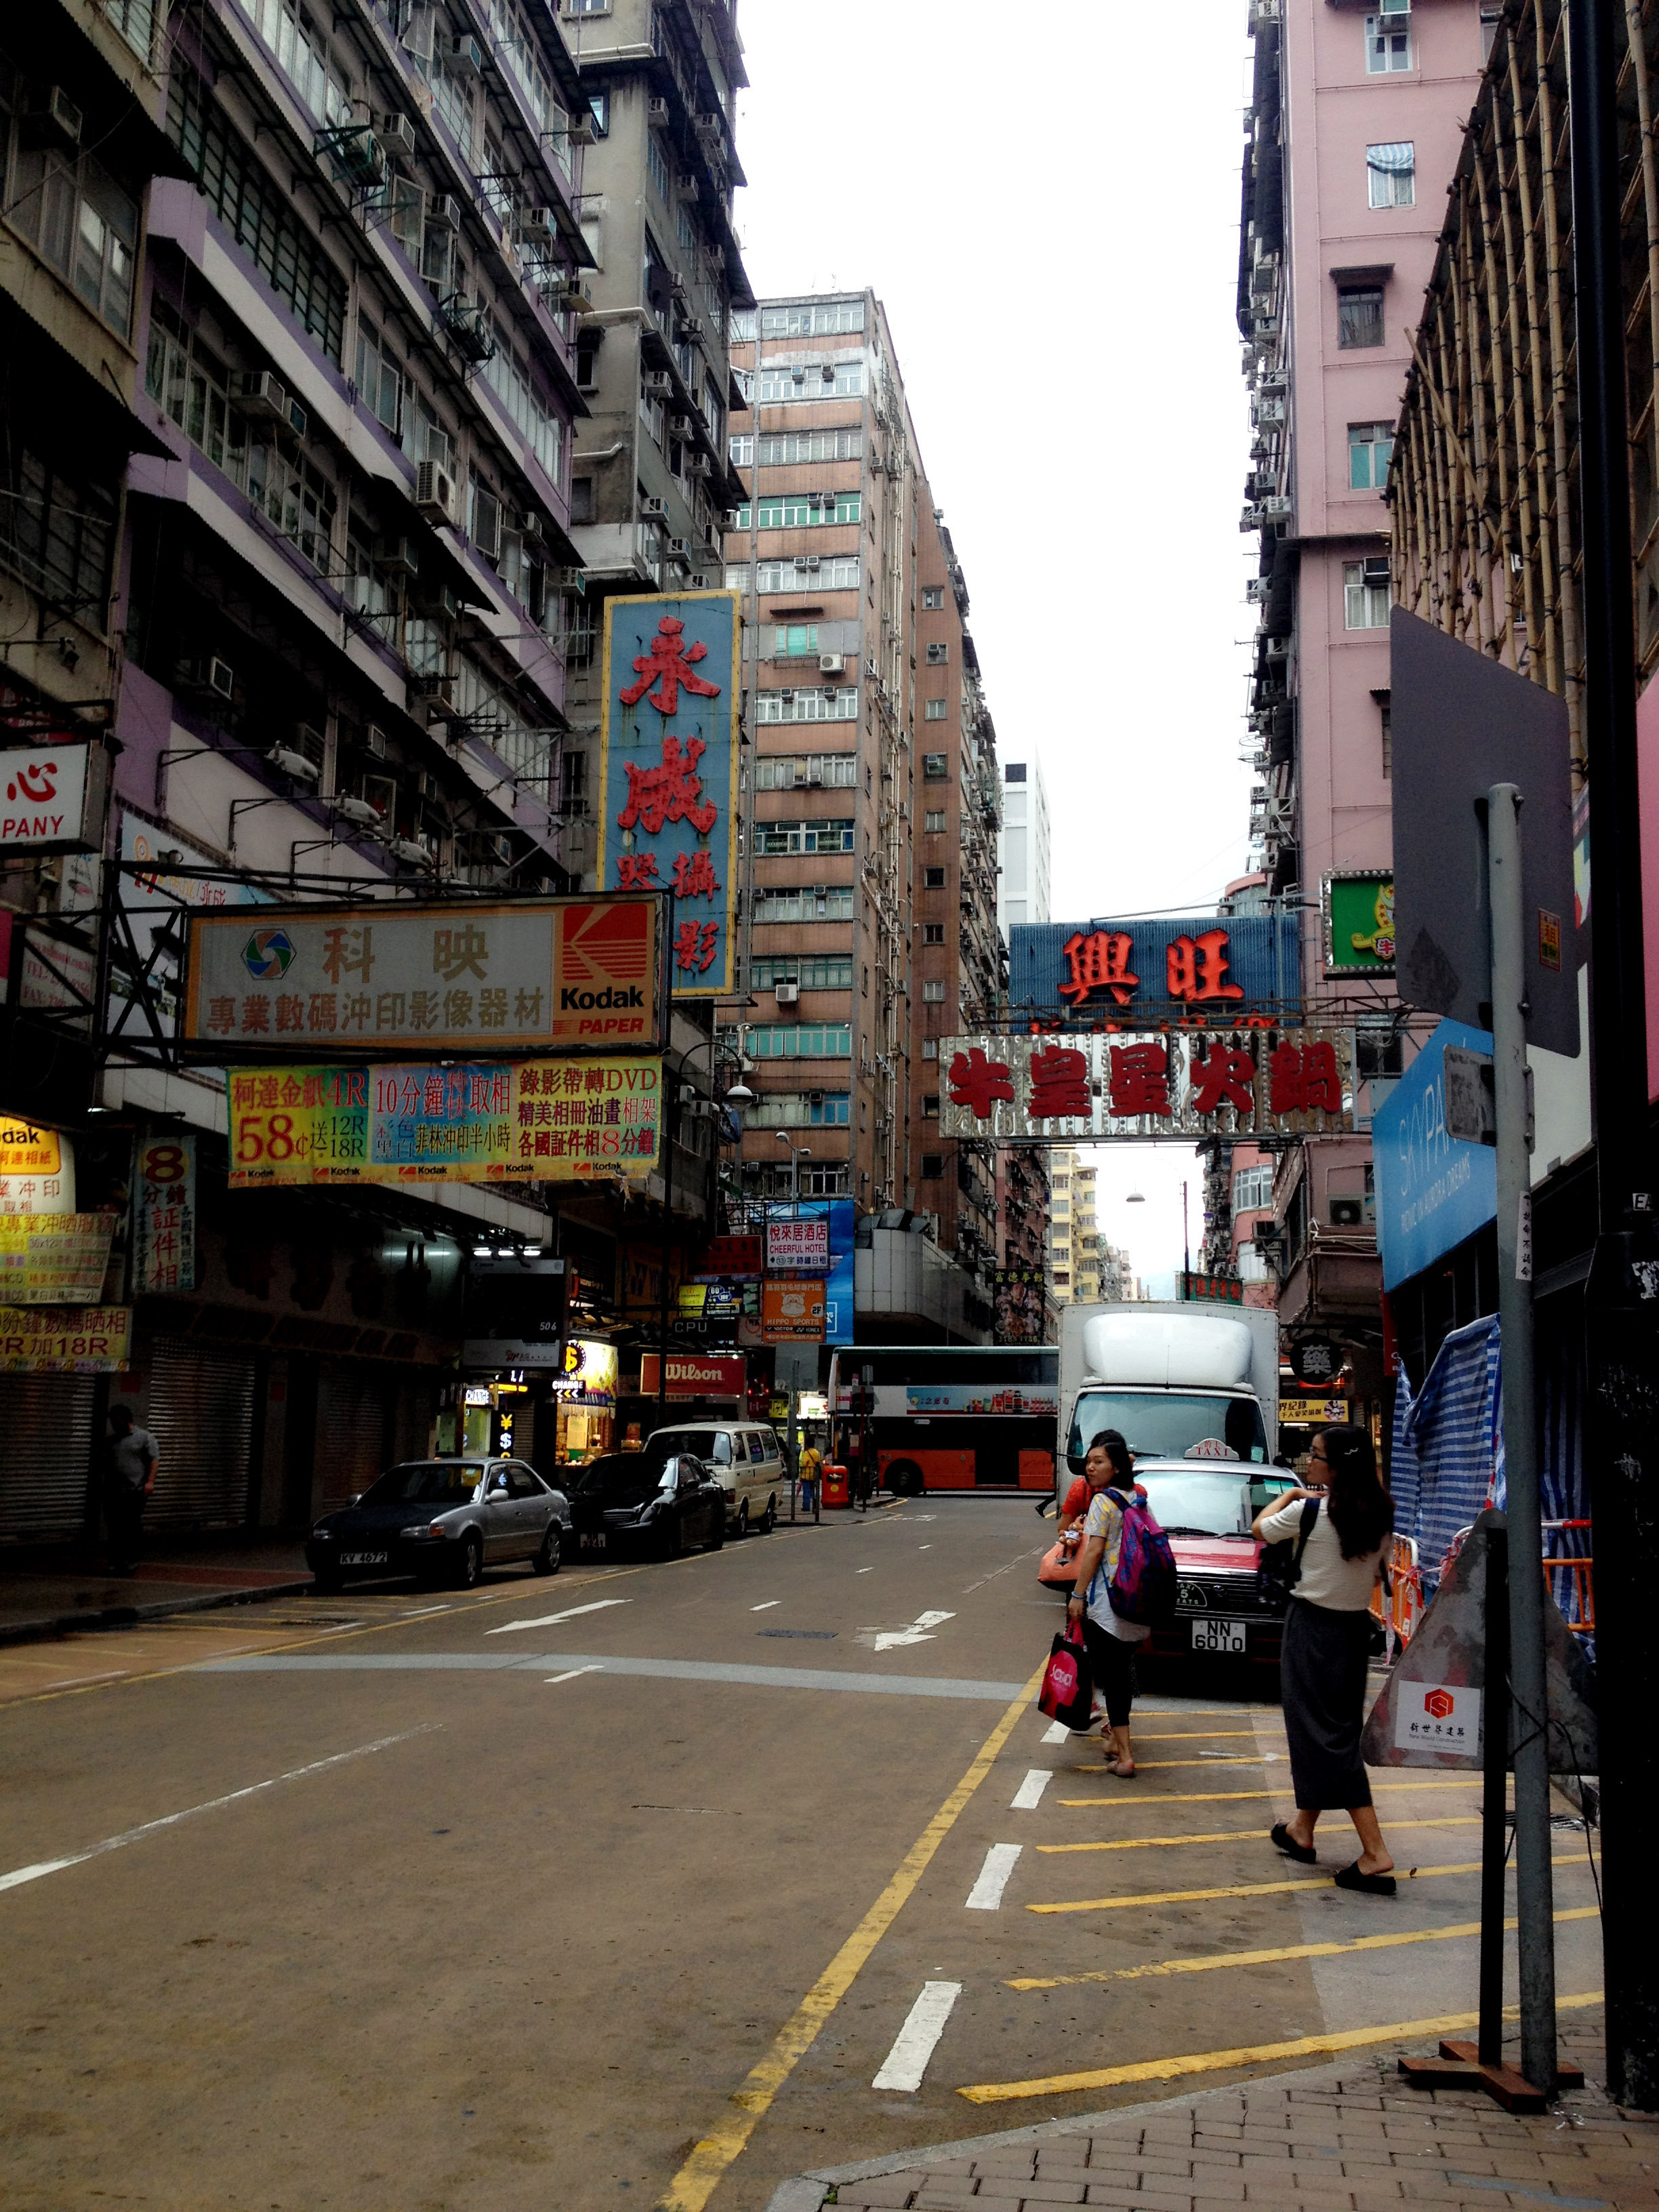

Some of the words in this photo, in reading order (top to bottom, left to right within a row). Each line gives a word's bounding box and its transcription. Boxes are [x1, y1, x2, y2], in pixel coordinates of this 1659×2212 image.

[618, 615, 721, 834] 永成
[7, 762, 58, 802] 心
[672, 851, 721, 972] 攝影
[1057, 927, 1245, 1006] 興旺
[560, 986, 644, 1011] Kodak
[207, 986, 544, 1035] 專業數碼沖印影像器材
[578, 1017, 644, 1034] PAPER
[949, 1040, 1342, 1120] 牛皇星火鍋
[330, 1116, 365, 1136] 12R
[0, 1126, 39, 1144] dak
[330, 1139, 363, 1158] 18R
[146, 1146, 184, 1183] 8
[418, 1166, 447, 1174] Kodak
[506, 1164, 534, 1172] Kodak
[592, 1162, 622, 1171] Kodak
[770, 1224, 826, 1242] 悅來居酒店
[770, 1244, 803, 1254] CHEERFUL
[805, 1244, 826, 1253] HOTEL
[812, 1306, 822, 1315] 2F
[539, 1322, 557, 1330] 506
[675, 1322, 708, 1333] CPU
[665, 1363, 722, 1380] Wilson
[552, 1380, 583, 1390] CHANGE
[1196, 1447, 1227, 1456] TAXI
[1180, 1589, 1189, 1599] 5
[1207, 1621, 1231, 1637] NN
[1195, 1635, 1243, 1651] 6010
